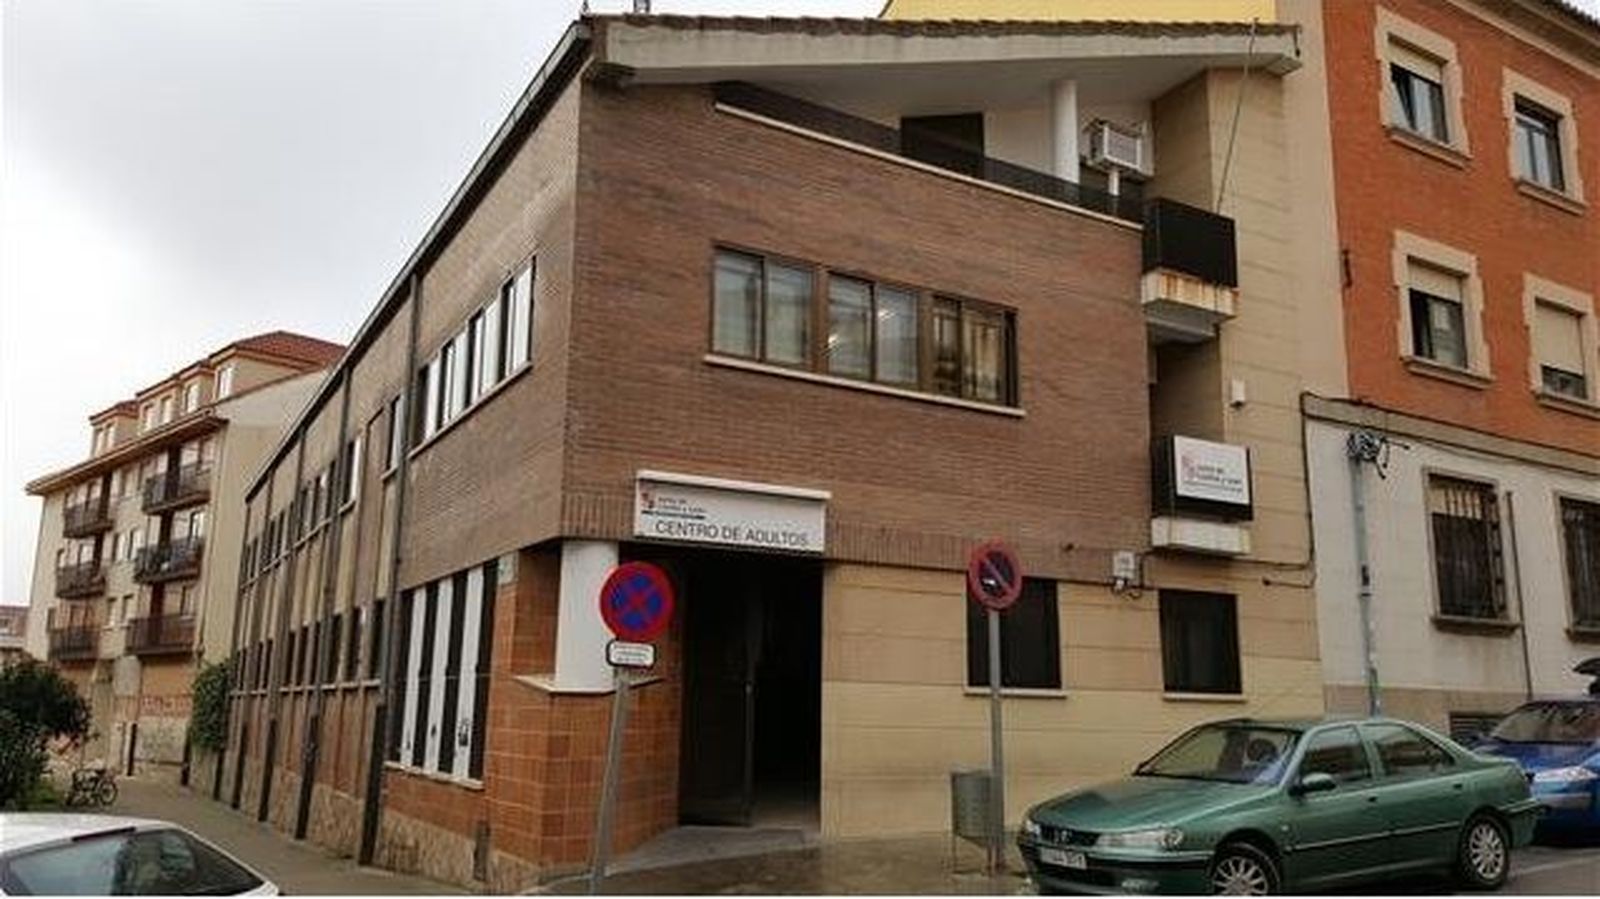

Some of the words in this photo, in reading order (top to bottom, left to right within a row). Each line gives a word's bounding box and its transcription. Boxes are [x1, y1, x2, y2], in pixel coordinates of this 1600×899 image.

[655, 519, 718, 539] CENTRO
[721, 525, 743, 540] DE
[746, 528, 808, 546] ADULTOS
